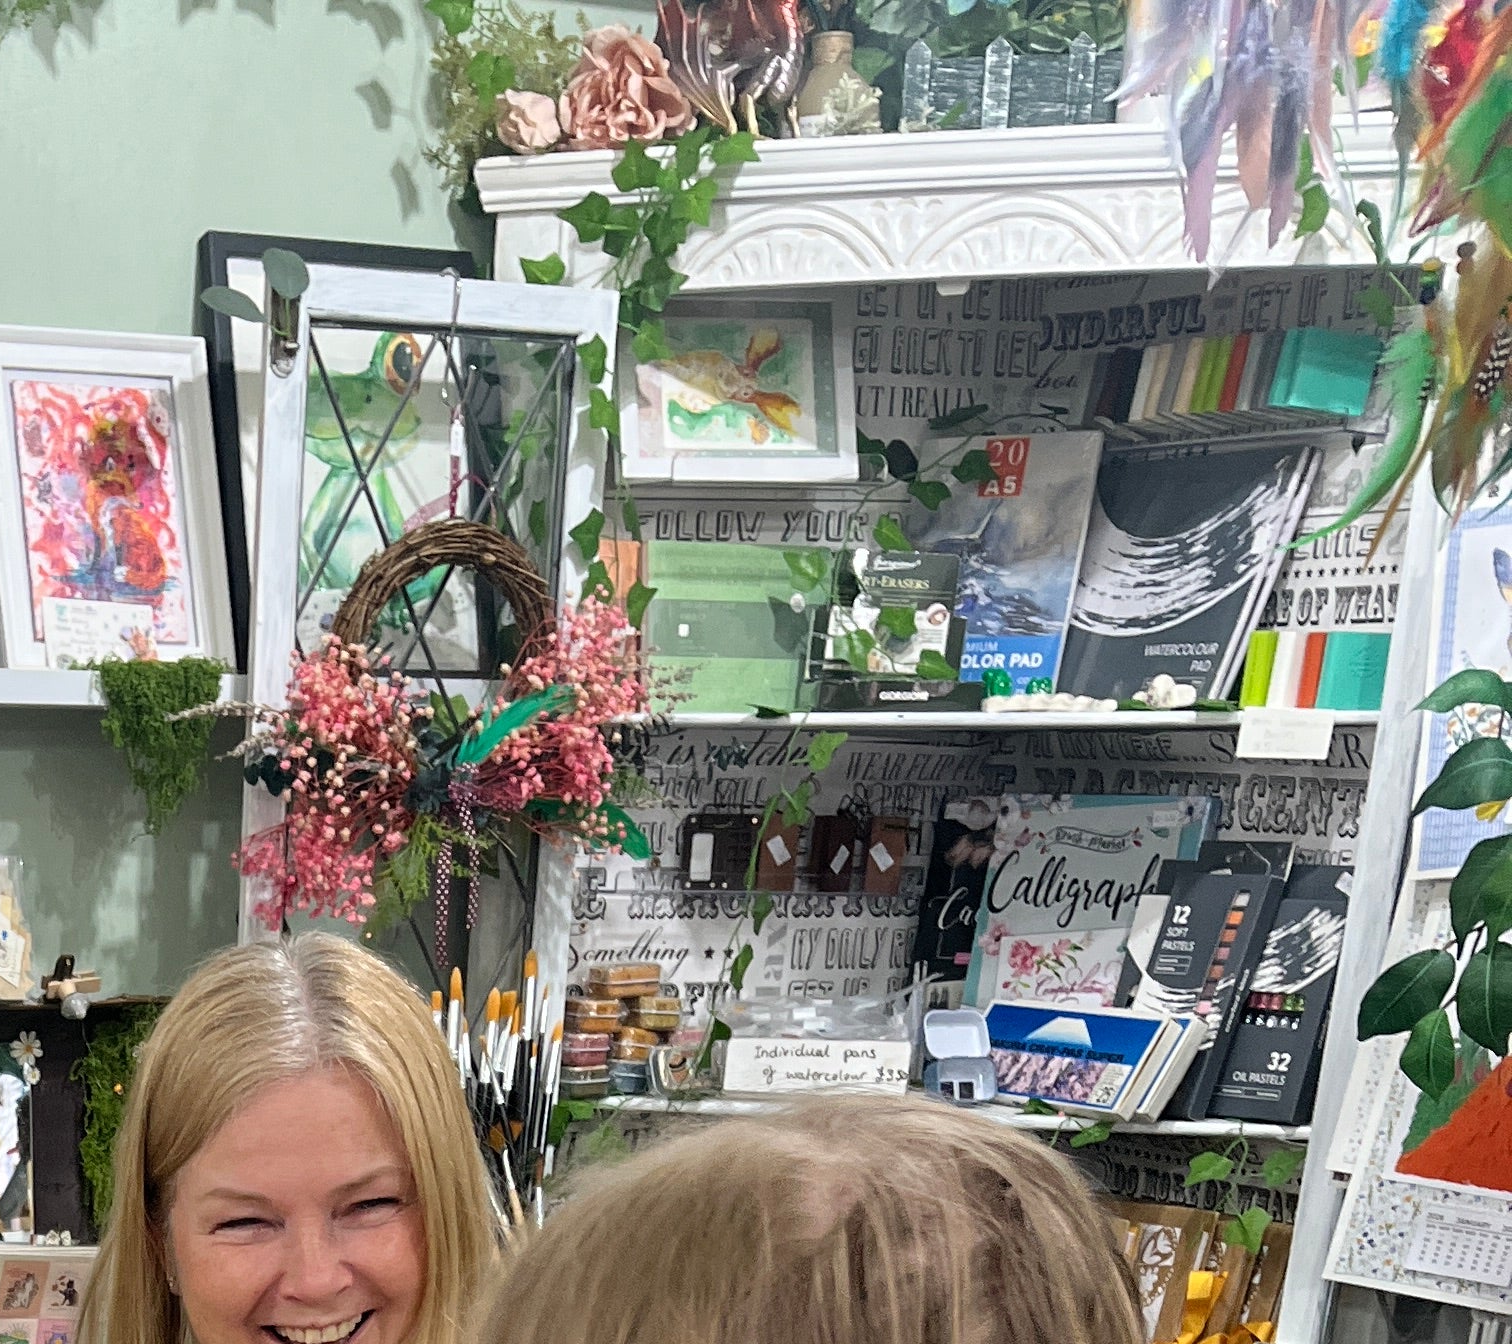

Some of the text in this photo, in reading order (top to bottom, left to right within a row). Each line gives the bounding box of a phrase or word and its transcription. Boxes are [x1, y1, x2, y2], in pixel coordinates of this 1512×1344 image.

[1039, 294, 1206, 350] ONDERFUL
[989, 440, 1025, 468] 20
[983, 476, 1018, 496] A5
[1144, 643, 1220, 657] WATERCOLOUR
[1009, 653, 1043, 668] PAD
[1189, 660, 1212, 673] PAD
[987, 849, 1160, 928] Calligraph
[1173, 905, 1191, 925] 12
[1165, 926, 1190, 938] SOFT
[1160, 940, 1196, 953] PASTELS
[753, 1045, 877, 1063] Individual pans
[1266, 1051, 1293, 1073] 32
[762, 1067, 775, 1081] of
[786, 1068, 868, 1081] watercolour
[1248, 1072, 1287, 1087] PASTELS
